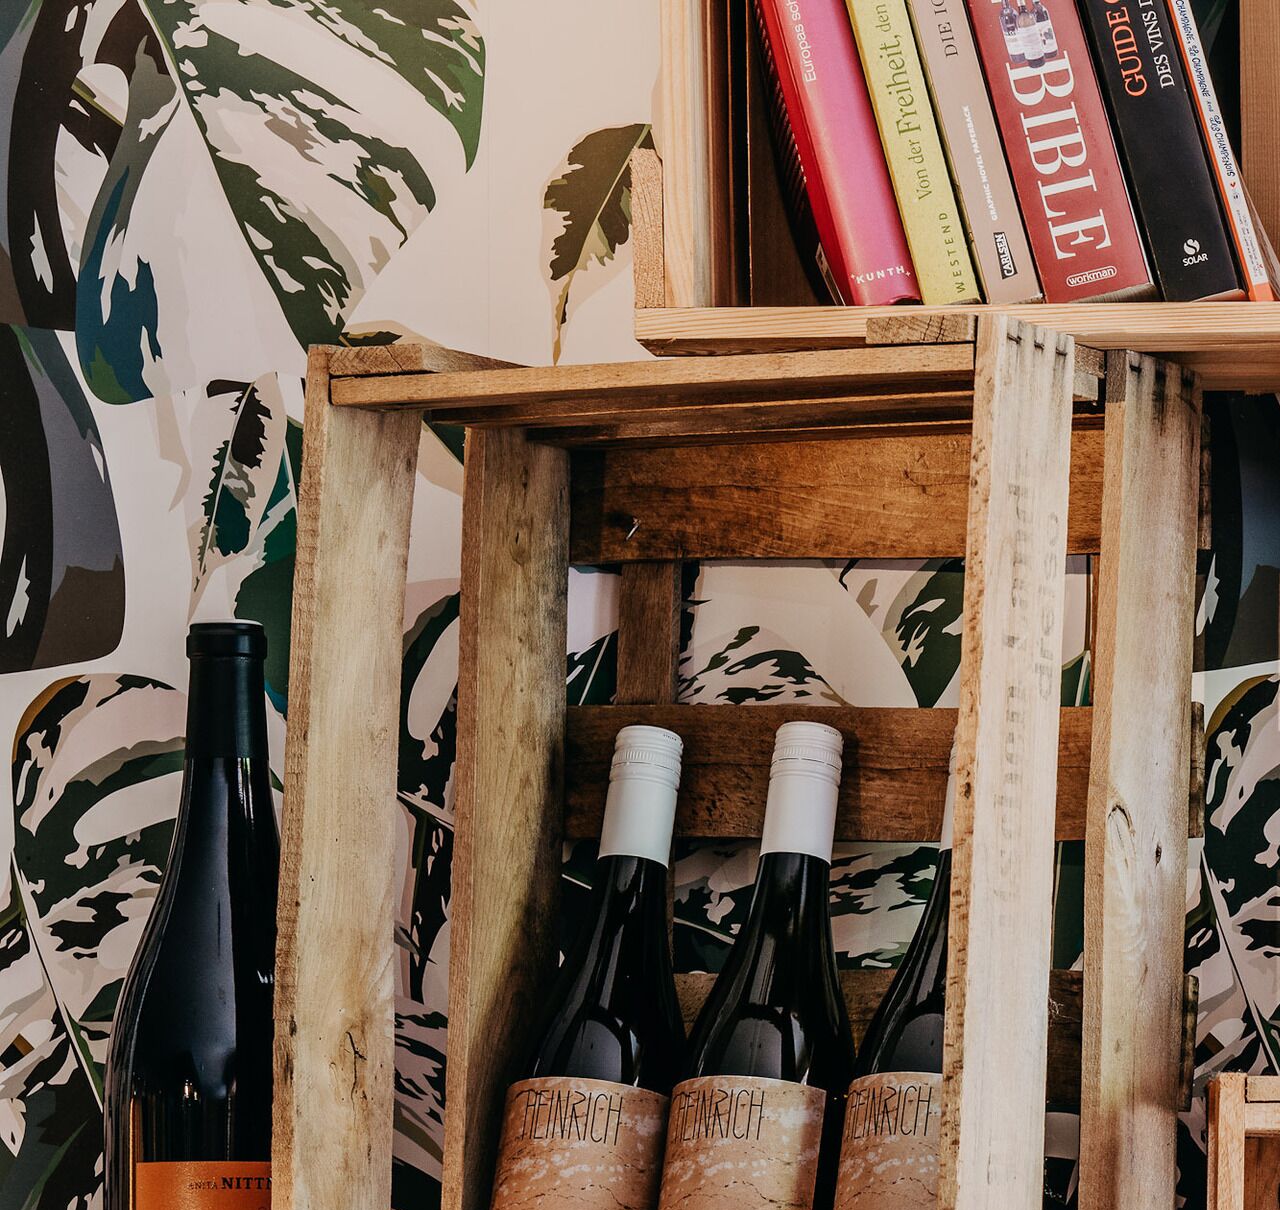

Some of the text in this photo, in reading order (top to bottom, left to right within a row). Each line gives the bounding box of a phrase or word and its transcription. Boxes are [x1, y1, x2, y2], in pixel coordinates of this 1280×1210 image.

[795, 23, 817, 83] Europas
[937, 22, 959, 57] DIE
[1105, 6, 1148, 97] GUIDE
[1141, 11, 1165, 53] VINS
[1153, 54, 1176, 89] DES
[875, 4, 933, 200] Von der Freiheit, den
[1191, 57, 1236, 177] CHAMPAGNE CHAMPENOIS
[961, 105, 998, 222] GRAPHIC NOVEL PAPERBACK
[1005, 50, 1112, 260] BIBLE
[856, 265, 905, 284] KUNTH
[938, 212, 966, 294] WESTEND
[994, 233, 1015, 277] CARLSEN
[1068, 267, 1115, 286] workman
[1182, 252, 1209, 267] SOLAR
[514, 1089, 623, 1145] HEINRICH
[673, 1088, 765, 1143] HEINRICH
